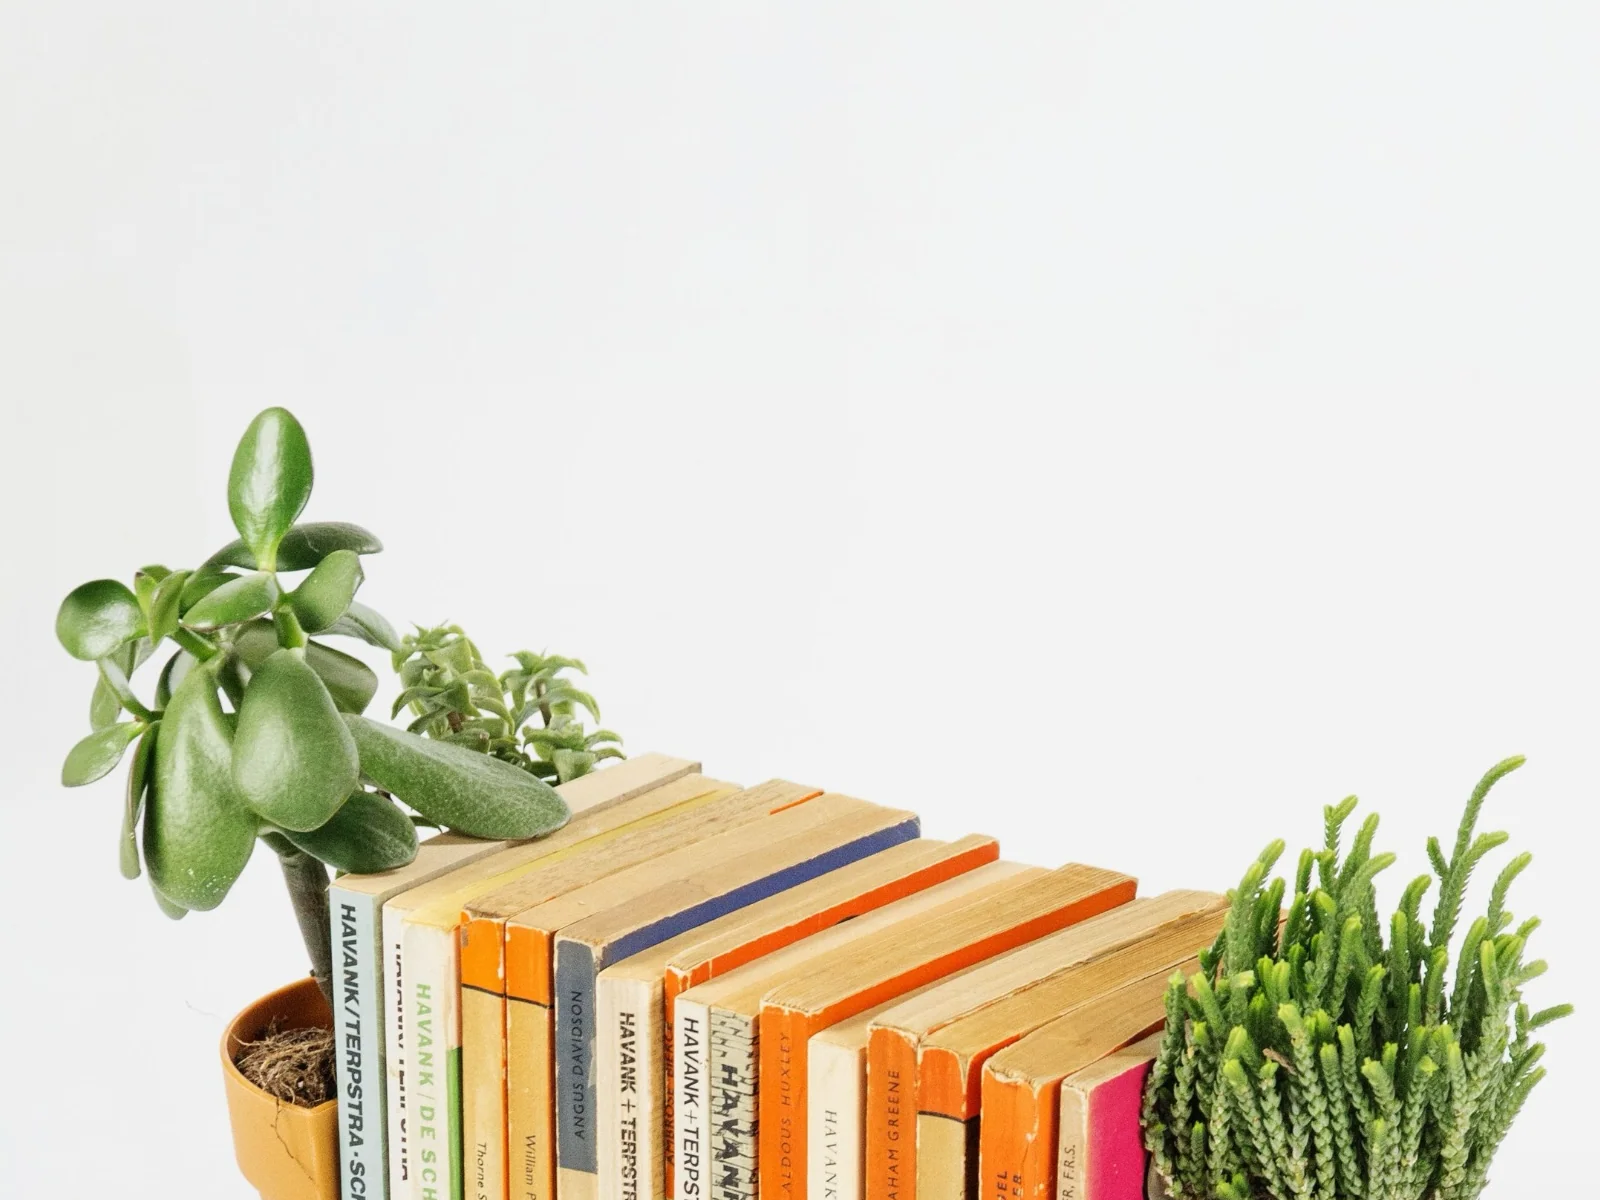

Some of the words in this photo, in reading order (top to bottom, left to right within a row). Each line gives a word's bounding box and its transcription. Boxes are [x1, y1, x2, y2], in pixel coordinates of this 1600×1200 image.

[341, 903, 364, 1147] HAVANK/TERPSTRA
[571, 991, 584, 1076] DAVIDSON
[619, 1012, 636, 1093] HAVANK
[780, 1033, 790, 1106] HUXLEY
[888, 1070, 900, 1141] GREENE
[573, 1083, 585, 1140] ANGUS
[477, 1142, 487, 1188] Thorne
[525, 1135, 536, 1185] William
[780, 1118, 791, 1193] ALDOUS
[1064, 1144, 1076, 1180] F.R.S.
